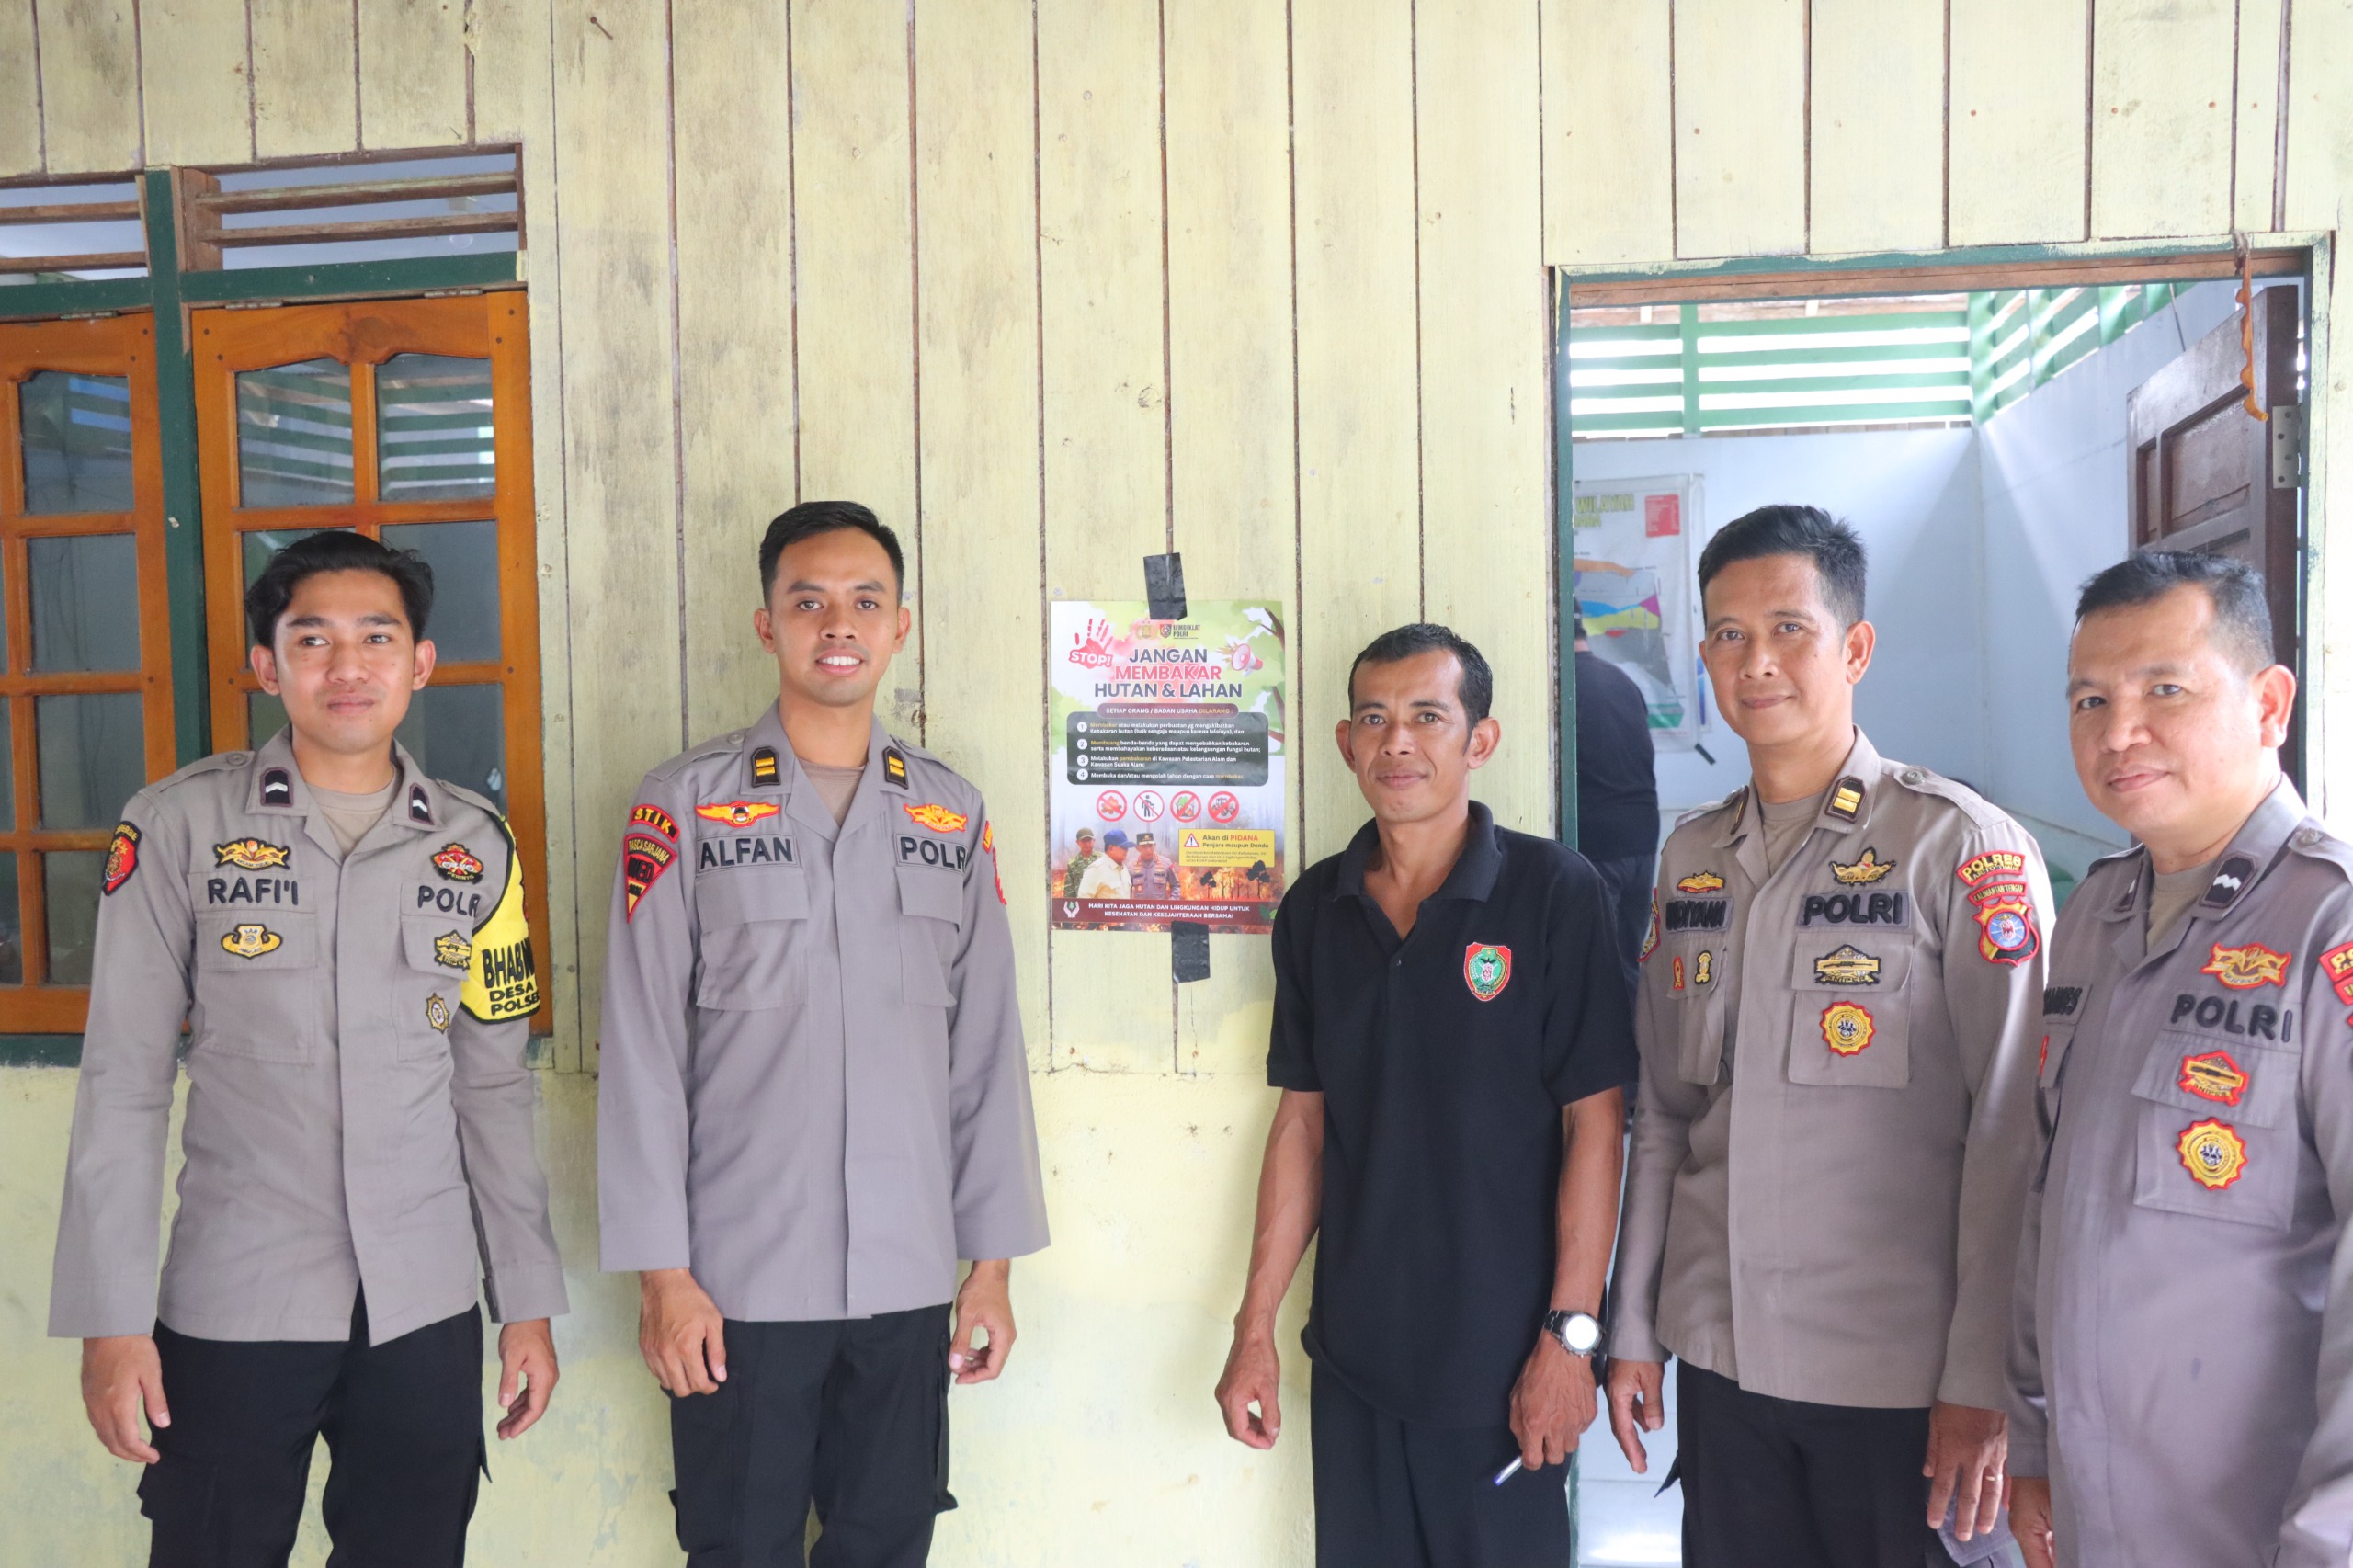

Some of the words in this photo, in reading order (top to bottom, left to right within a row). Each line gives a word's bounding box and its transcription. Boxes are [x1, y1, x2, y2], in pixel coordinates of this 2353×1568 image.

[1070, 651, 1111, 667] STOP!
[1129, 648, 1208, 663] JANGAN
[1115, 665, 1222, 680] MEMBAKAR
[1095, 683, 1157, 698] HUTAN
[1161, 684, 1176, 698] &
[1180, 683, 1243, 698] LAHAN
[634, 808, 672, 834] STIK
[700, 837, 793, 869] ALFAN
[900, 836, 966, 869] POLR
[1961, 853, 2022, 882] POLRES
[207, 877, 299, 906] RAFI'I
[417, 885, 481, 917] POLR
[1802, 892, 1903, 926] POLRI
[489, 981, 534, 1002] DESA
[490, 990, 540, 1017] POLSE
[2170, 994, 2294, 1043] POLRI
